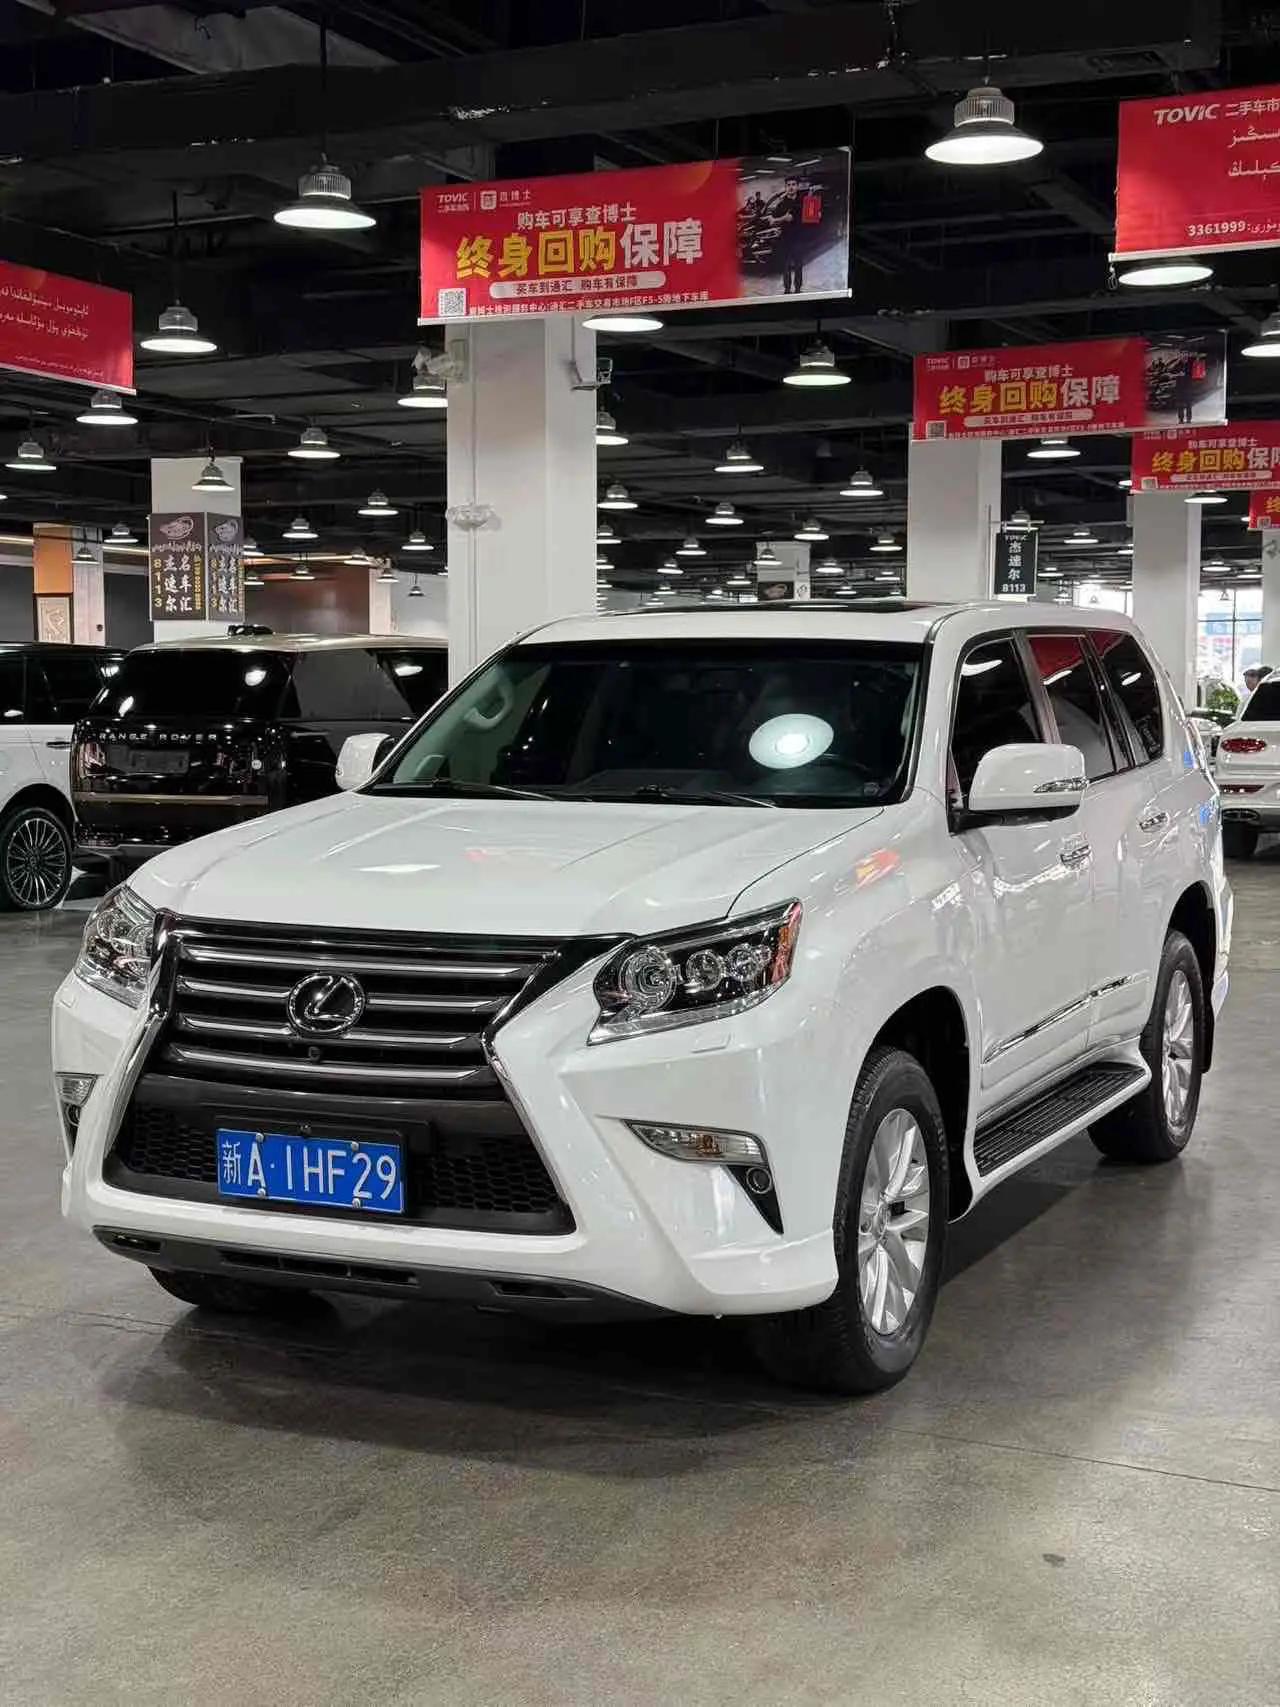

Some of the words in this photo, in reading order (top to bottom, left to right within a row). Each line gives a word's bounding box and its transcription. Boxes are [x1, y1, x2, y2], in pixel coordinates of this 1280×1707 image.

[1153, 104, 1220, 125] TOVIC
[437, 192, 468, 204] TOVIC
[517, 203, 637, 230] 购车可享查博士
[1188, 220, 1246, 237] 3361999
[456, 217, 704, 279] 终身回购保障
[939, 375, 1120, 414] 终身回购保障
[99, 732, 148, 741] RANGE
[160, 732, 217, 742] ROVER
